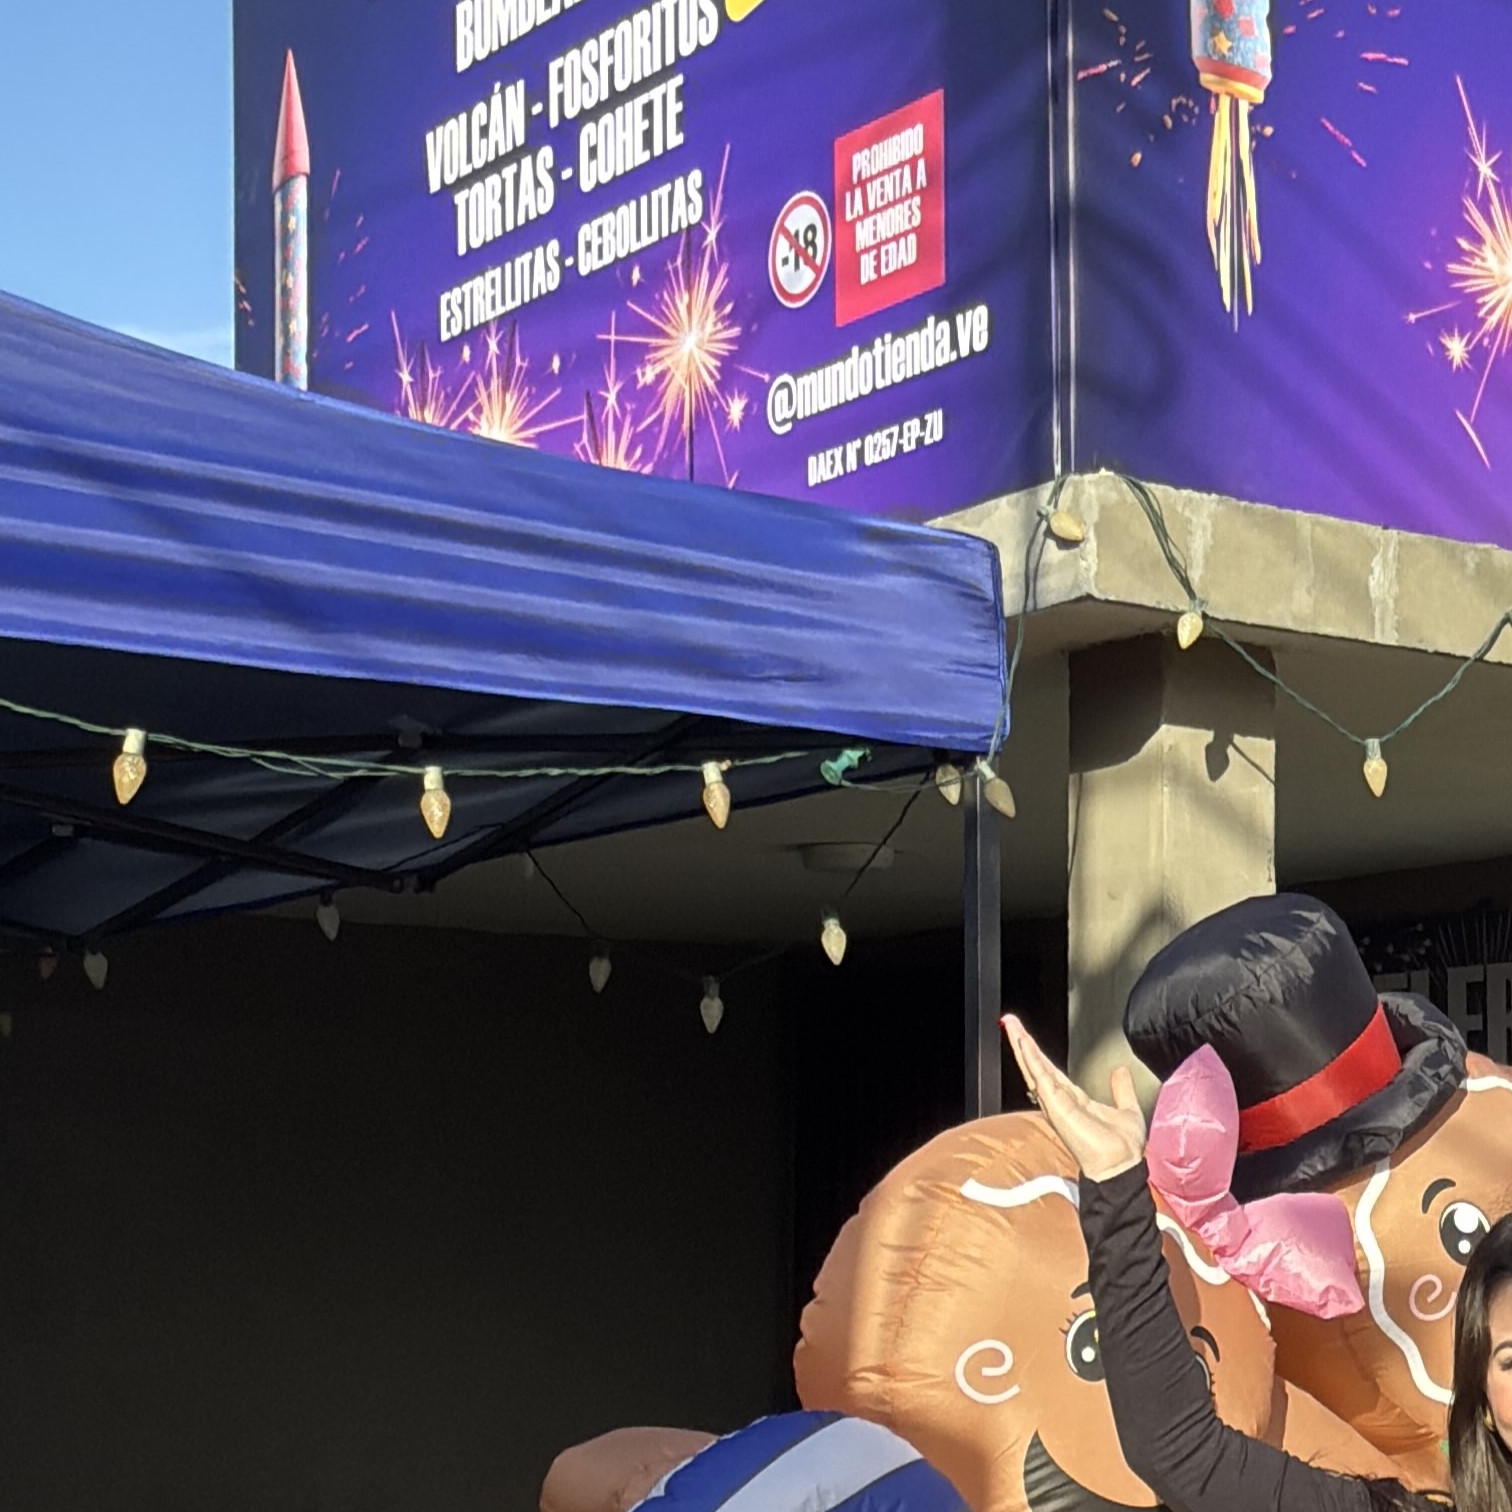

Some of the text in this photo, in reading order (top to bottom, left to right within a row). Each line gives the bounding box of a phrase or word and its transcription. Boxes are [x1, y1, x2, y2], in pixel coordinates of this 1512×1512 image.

[425, 79, 527, 194] VOLCÁN
[454, 75, 685, 257] TORTAS COHETE
[851, 123, 925, 176] PROHIBIDO
[845, 158, 928, 223] LA VENTA A
[855, 198, 922, 253] MENORES
[439, 169, 704, 342] ESTRELLITAS CEBOLLITAS
[859, 232, 918, 286] DE EDAD
[766, 303, 990, 436] @mundotienda.ve
[807, 443, 844, 488] DAEX
[864, 408, 944, 467] 0257-EP-ZU
